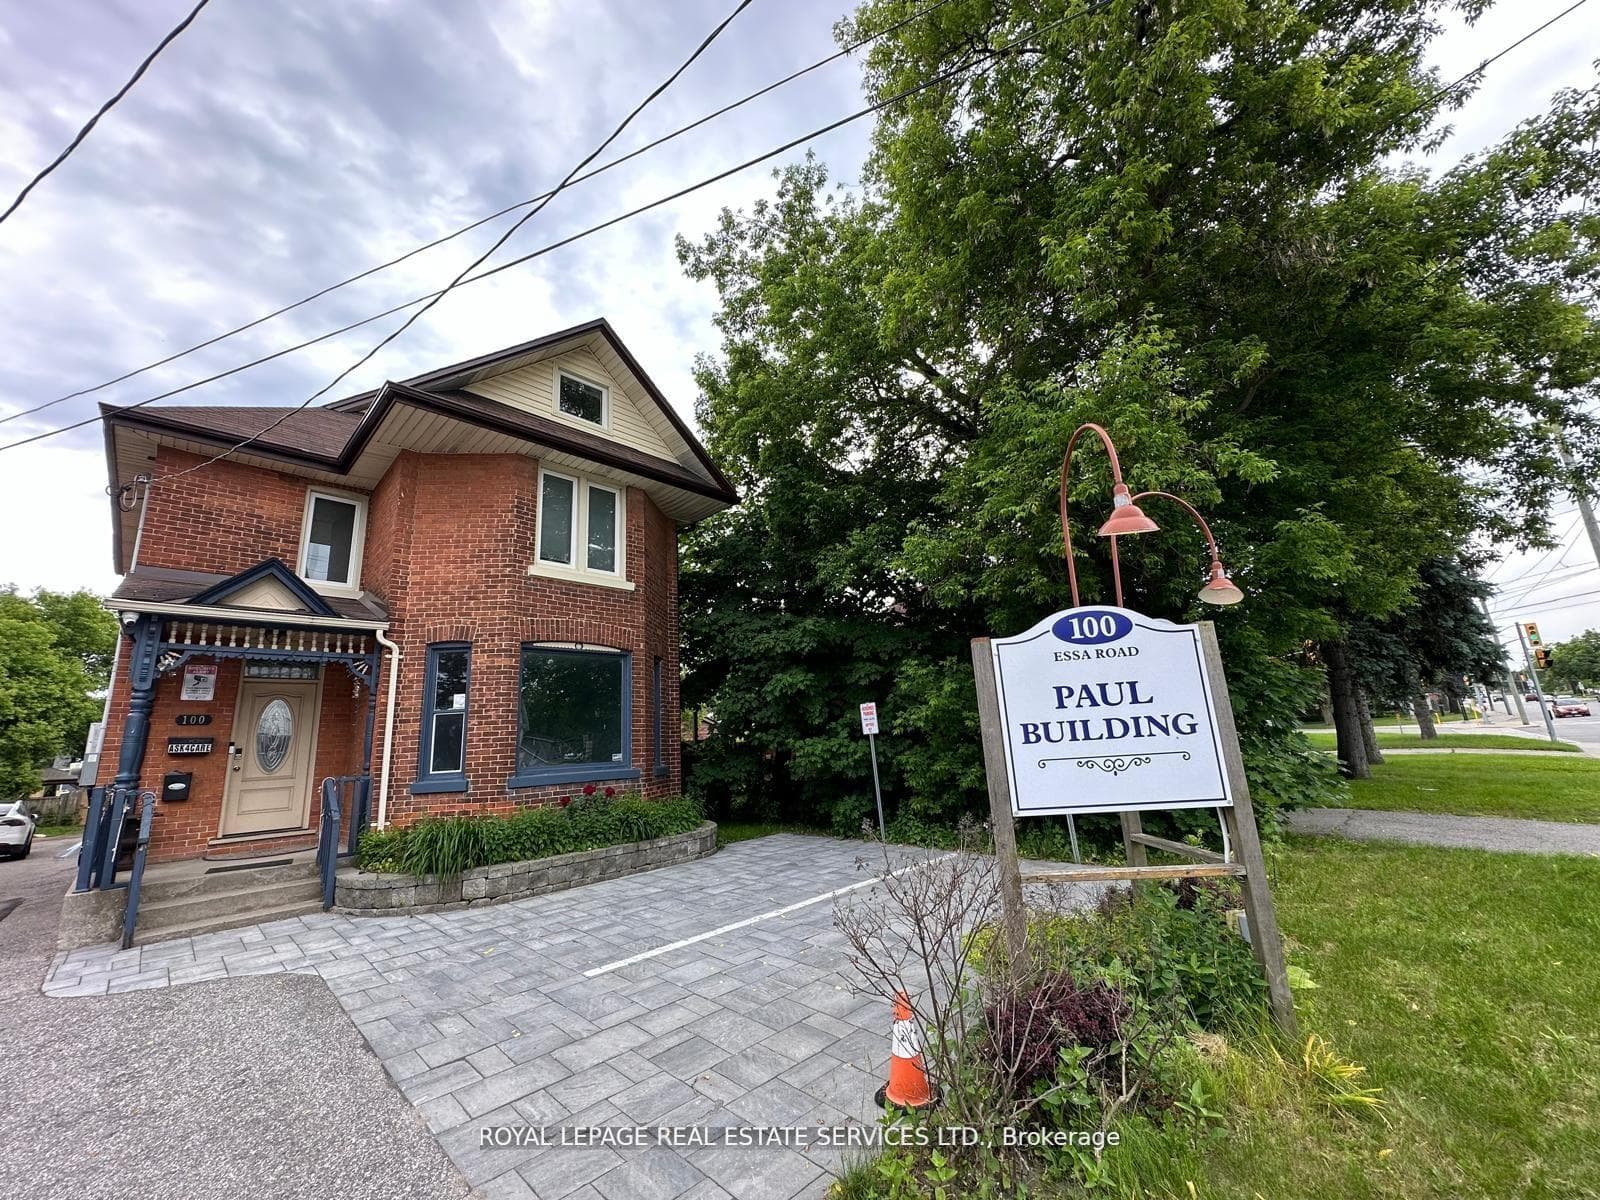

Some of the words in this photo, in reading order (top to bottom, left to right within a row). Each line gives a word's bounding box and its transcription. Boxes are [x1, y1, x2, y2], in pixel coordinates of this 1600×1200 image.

[1069, 615, 1116, 639] 100
[1053, 650, 1091, 662] ESSA
[1096, 646, 1139, 659] ROAD
[1053, 681, 1154, 709] PAUL
[183, 715, 205, 724] 100
[1020, 713, 1199, 744] BUILDING
[169, 744, 211, 752] ASK4CARE
